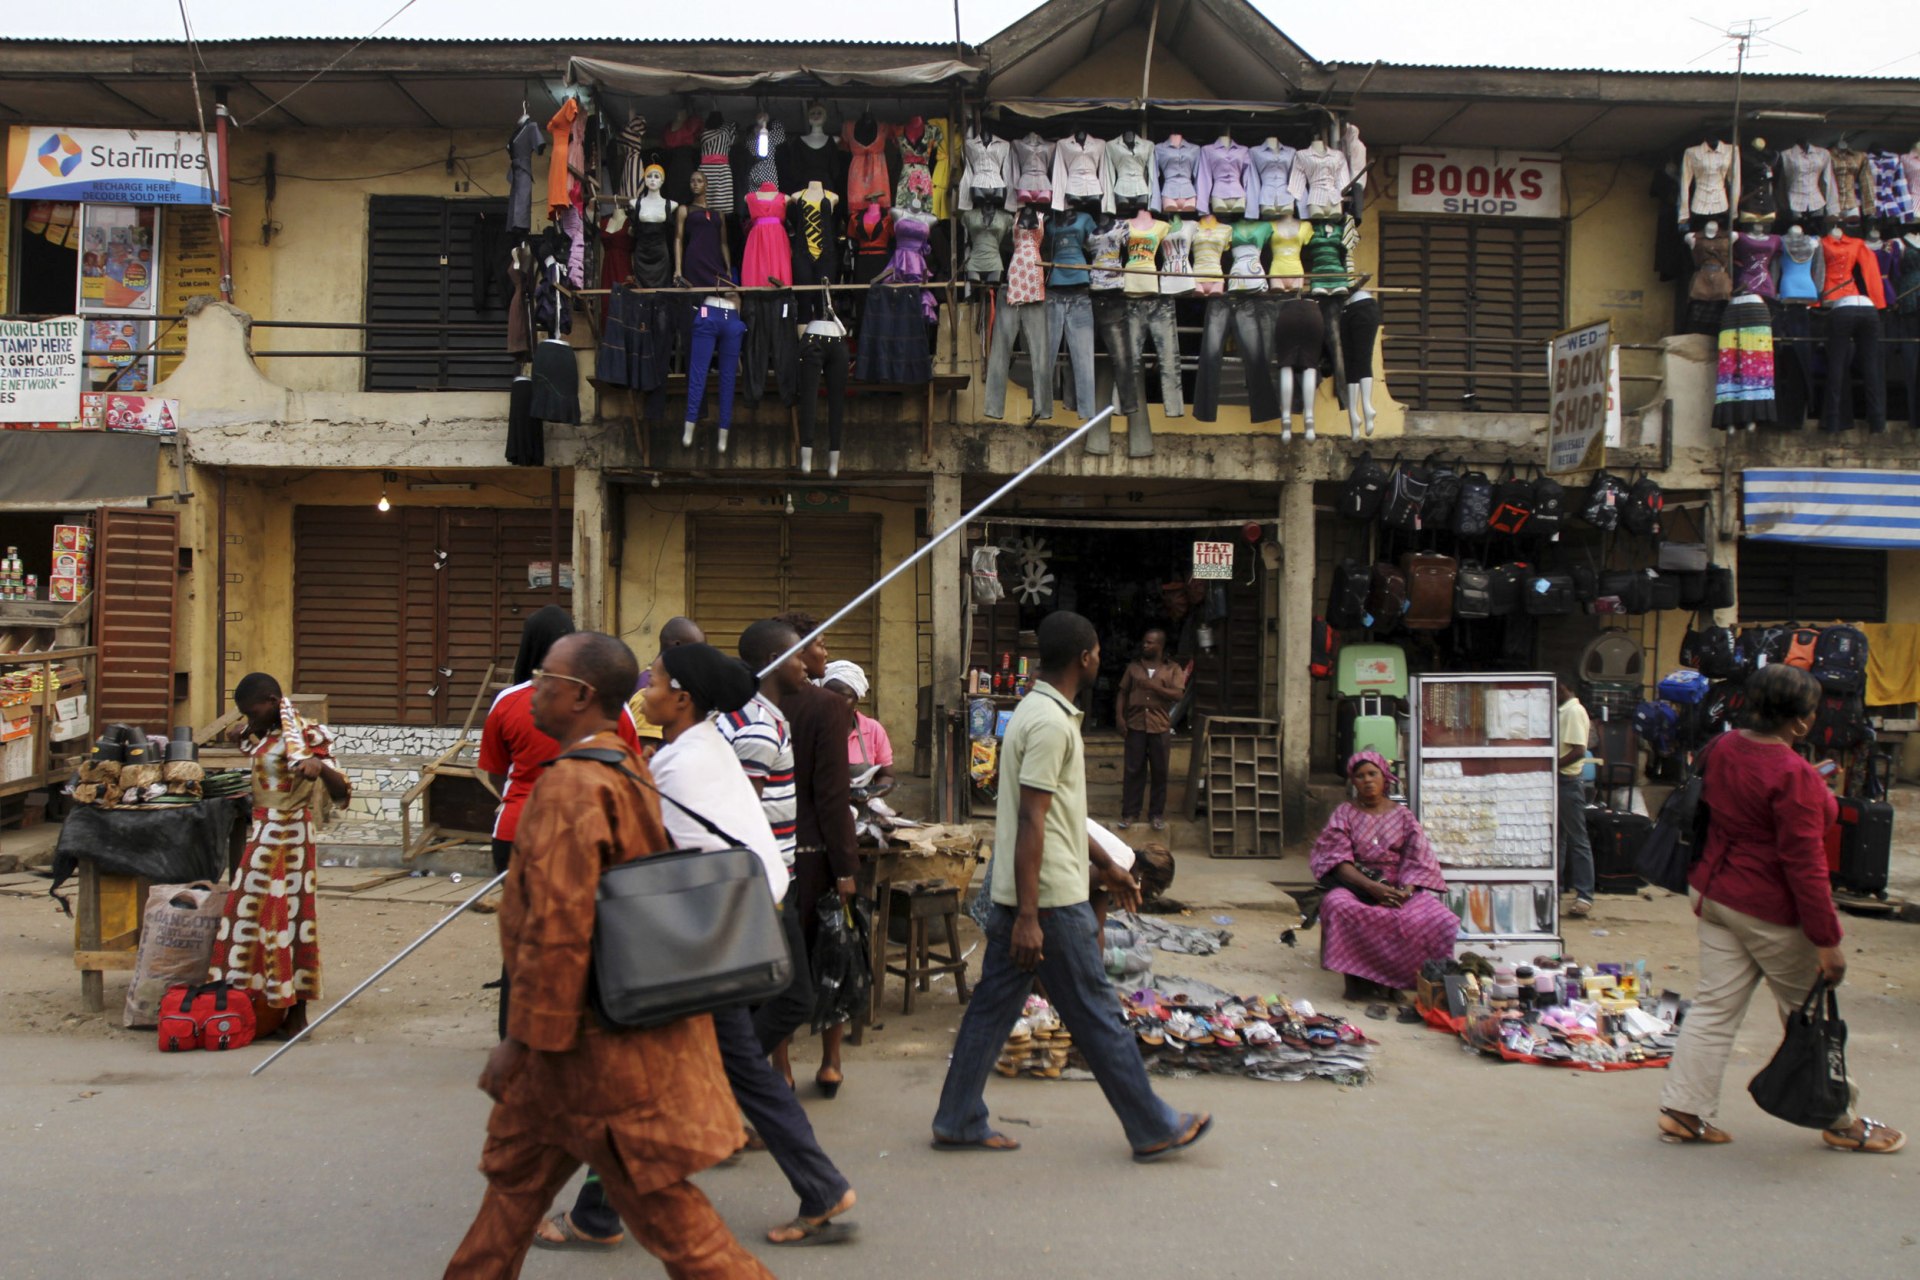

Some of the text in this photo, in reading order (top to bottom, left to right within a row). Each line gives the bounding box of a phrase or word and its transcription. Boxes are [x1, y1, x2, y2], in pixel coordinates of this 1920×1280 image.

[90, 145, 208, 170] StarTimes
[92, 182, 171, 192] RECHARGE HERE
[1411, 163, 1543, 200] BOOKS
[82, 191, 182, 202] DECODER SOLD HERE
[1443, 198, 1518, 215] SHOP
[30, 322, 78, 337] LETTER
[41, 338, 73, 353] HERE
[9, 354, 35, 367] GSM
[36, 353, 76, 367] CARDS
[1, 368, 21, 378] ZAIN
[1555, 346, 1606, 393] BOOK
[1553, 392, 1603, 436] SHOP
